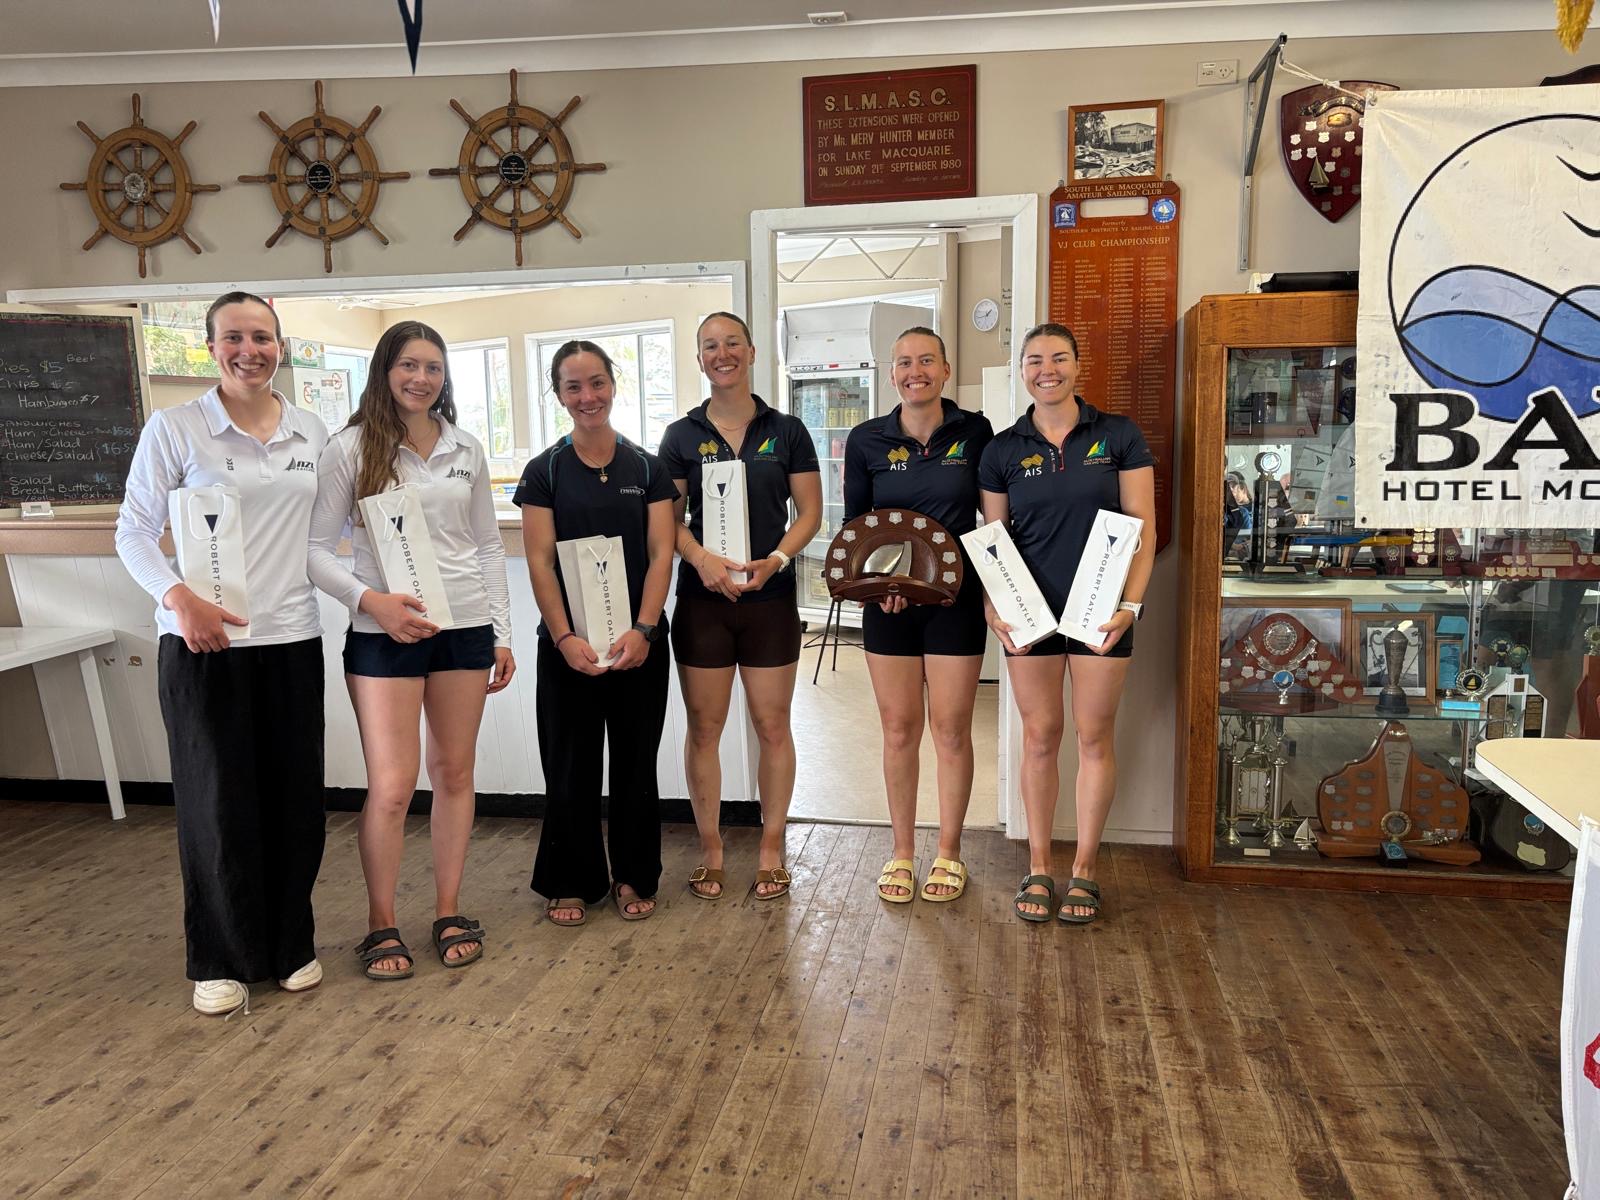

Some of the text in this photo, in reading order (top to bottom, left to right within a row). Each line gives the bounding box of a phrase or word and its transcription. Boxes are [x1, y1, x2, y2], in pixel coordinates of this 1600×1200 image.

[817, 110, 960, 130] THESE EXTENSIONS WERE OPENED
[818, 136, 829, 148] BY
[851, 132, 874, 145] MERV
[880, 129, 912, 143] HUNTER
[917, 128, 955, 141] MEMBER
[818, 152, 836, 163] FOR
[846, 150, 871, 161] LAKE
[818, 166, 829, 177] ON
[835, 164, 866, 176] SUNDAY
[891, 160, 938, 173] SEPTEMBER
[941, 158, 962, 169] 1980
[1064, 181, 1164, 194] SOUTH LAKE MACQUARIE
[1066, 191, 1102, 200] AMATEUR
[1058, 236, 1170, 249] VJ CLUB CHAMPIONSHIP
[5, 429, 36, 438] Ham
[1385, 390, 1600, 472] BA
[702, 455, 718, 464] AIS
[890, 461, 907, 471] AIS
[1024, 466, 1042, 478] AIS
[9, 475, 52, 485] Salad
[11, 486, 46, 496] Bread
[1383, 480, 1522, 501] HOTEL
[400, 536, 417, 577] ROBERT
[209, 536, 222, 606] ROBERT OAT
[997, 560, 1036, 628] ROBERT OATLEY
[1081, 553, 1110, 629] ROBERT OATLEY
